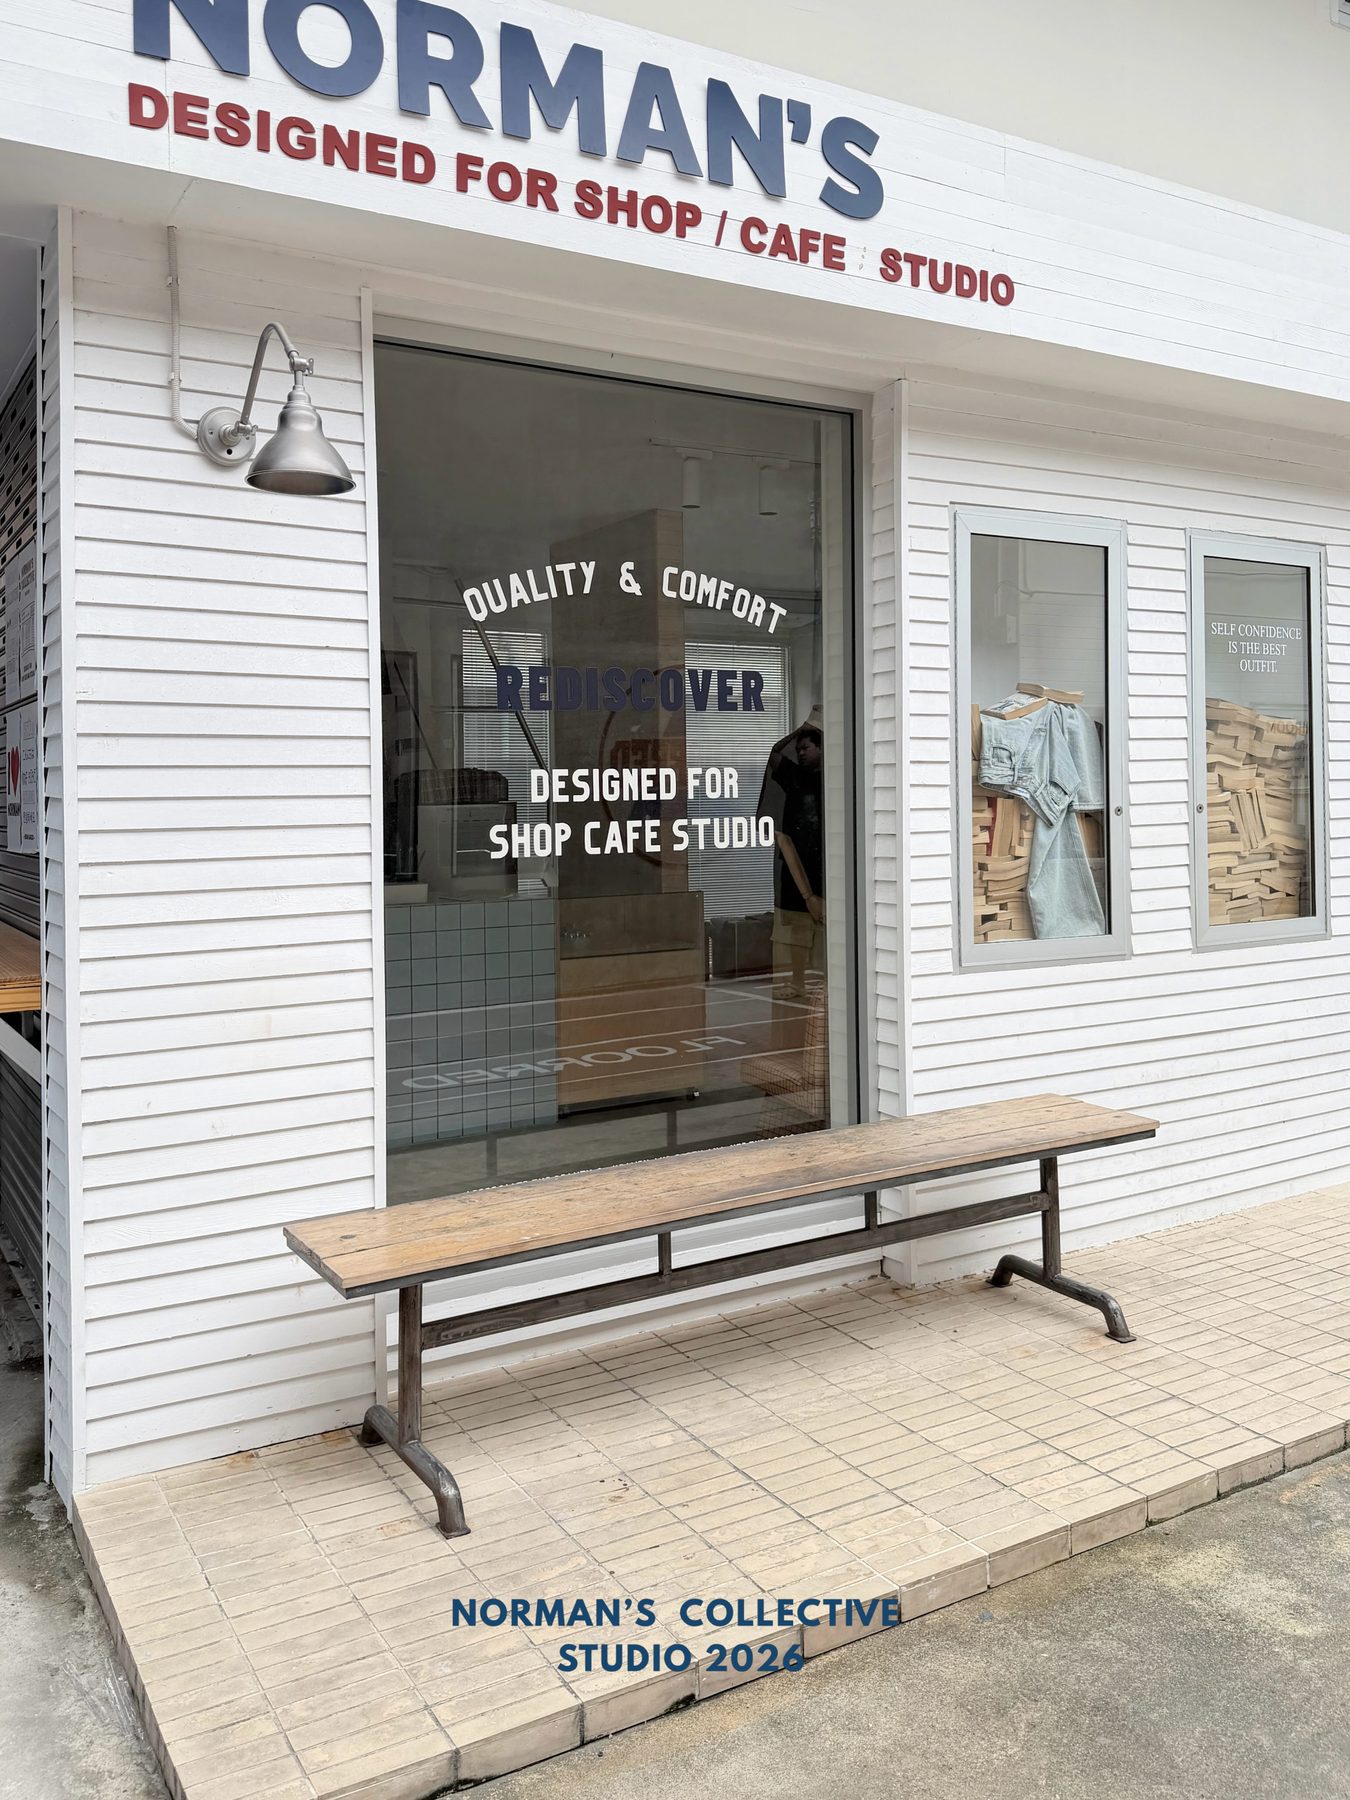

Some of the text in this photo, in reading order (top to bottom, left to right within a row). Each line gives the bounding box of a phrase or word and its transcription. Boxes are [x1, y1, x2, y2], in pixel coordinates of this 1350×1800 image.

[128, 83, 436, 184] DESIGNED
[456, 153, 559, 212] FOR
[575, 180, 703, 240] SHOP
[740, 216, 846, 271] CAFE
[880, 247, 1015, 307] STUDIO
[463, 561, 787, 634] QUALITY & COMFORT
[1211, 622, 1302, 640] SELF CONFIDENCE
[1228, 641, 1287, 656] IS THE BEST
[1240, 659, 1278, 673] OUTFIT.
[497, 664, 766, 712] REDISCOVER
[530, 767, 739, 803] DESIGNED FOR
[489, 815, 775, 859] SHOP CAFE STUDIO
